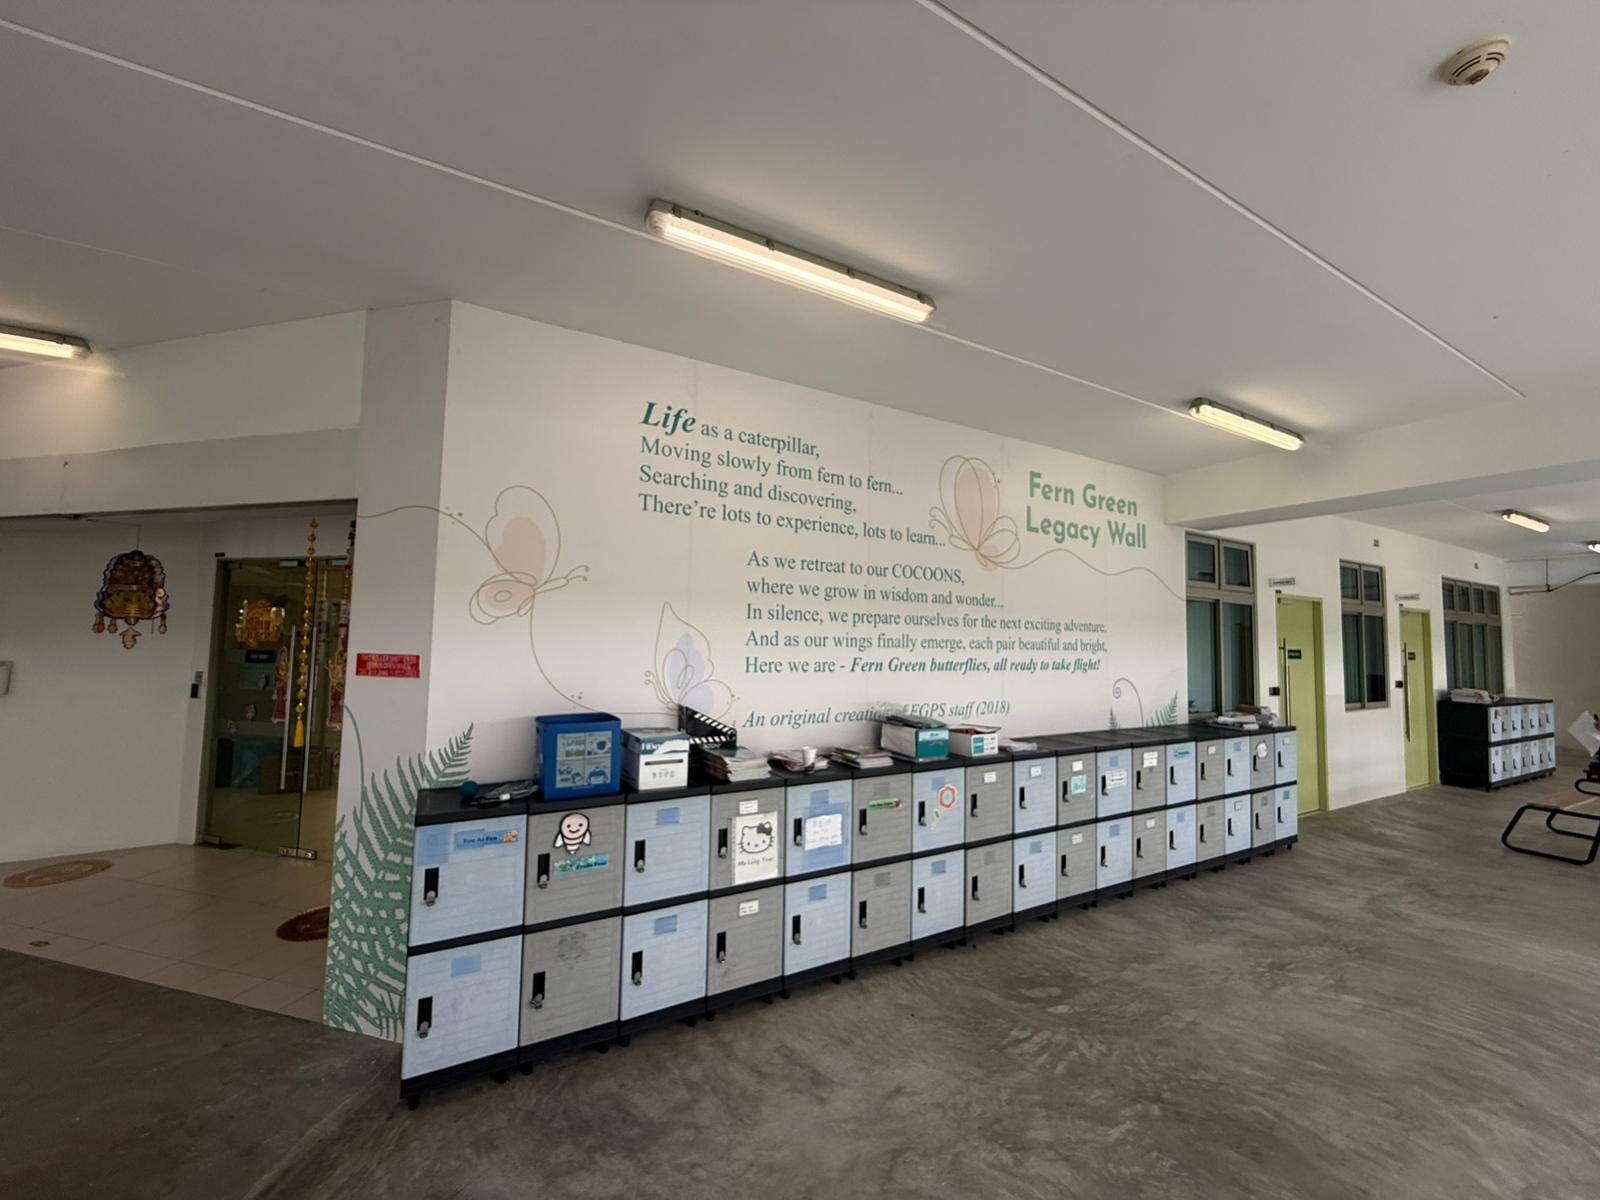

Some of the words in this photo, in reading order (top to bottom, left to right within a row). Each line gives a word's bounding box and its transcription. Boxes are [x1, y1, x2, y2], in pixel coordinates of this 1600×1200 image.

[640, 401, 696, 435] Life
[701, 422, 719, 438] as
[724, 426, 733, 439] a
[738, 430, 820, 459] caterpillar,
[640, 436, 711, 468] Moving
[717, 450, 771, 476] slowly
[777, 460, 812, 480] from
[818, 467, 845, 486] fern
[849, 473, 862, 488] to
[867, 476, 903, 495] fern...
[639, 464, 728, 497] Searching
[734, 481, 762, 498] and
[768, 484, 856, 515] discovering,
[1029, 471, 1074, 505] Fern
[1083, 483, 1137, 516] Green
[723, 504, 751, 523] lots
[757, 511, 771, 525] to
[776, 513, 858, 537] experience,
[864, 523, 886, 539] lots
[890, 528, 901, 541] to
[907, 529, 945, 546] learn...
[1026, 506, 1100, 548] Legacy
[1107, 520, 1146, 548] Wall
[747, 551, 769, 568] As
[775, 556, 796, 569] we
[801, 558, 845, 574] retreat
[850, 562, 862, 575] to
[867, 564, 888, 577] our
[892, 563, 965, 584] COCOONS,
[747, 577, 793, 595] where
[799, 586, 820, 597] we
[824, 586, 859, 601] grow
[864, 584, 875, 600] in
[880, 586, 928, 603] wisdom
[932, 589, 952, 604] and
[956, 594, 1004, 608] wonder...
[747, 603, 762, 620] In
[768, 604, 824, 623] silence,
[828, 612, 848, 623] we
[852, 611, 900, 628] prepare
[904, 611, 958, 628] ourselves
[963, 613, 978, 628] for
[981, 614, 997, 629] the
[1000, 617, 1021, 630] next
[1024, 618, 1061, 634] exciting
[745, 631, 779, 648] And
[784, 636, 799, 648] as
[804, 636, 828, 648] our
[833, 633, 872, 652] wings
[877, 632, 918, 651] finally
[921, 637, 966, 652] emerge,
[969, 636, 993, 651] each
[996, 637, 1016, 653] pair
[1019, 637, 1059, 651] beautiful
[1063, 638, 1078, 651] and
[1080, 638, 1108, 652] bright,
[745, 657, 782, 674] Here
[788, 661, 809, 673] we
[814, 661, 836, 673] are
[850, 658, 883, 672] Fern
[888, 658, 926, 672] Green
[930, 658, 990, 673] butterflies,
[994, 658, 1007, 671] all
[1010, 659, 1038, 673] ready
[1041, 660, 1049, 671] to
[1052, 658, 1071, 672] take
[1073, 658, 1100, 674] flight!
[742, 711, 765, 728] An
[770, 707, 831, 729] original
[834, 706, 886, 722] creatio
[948, 700, 976, 719] staff
[976, 701, 1010, 717] (2018)
